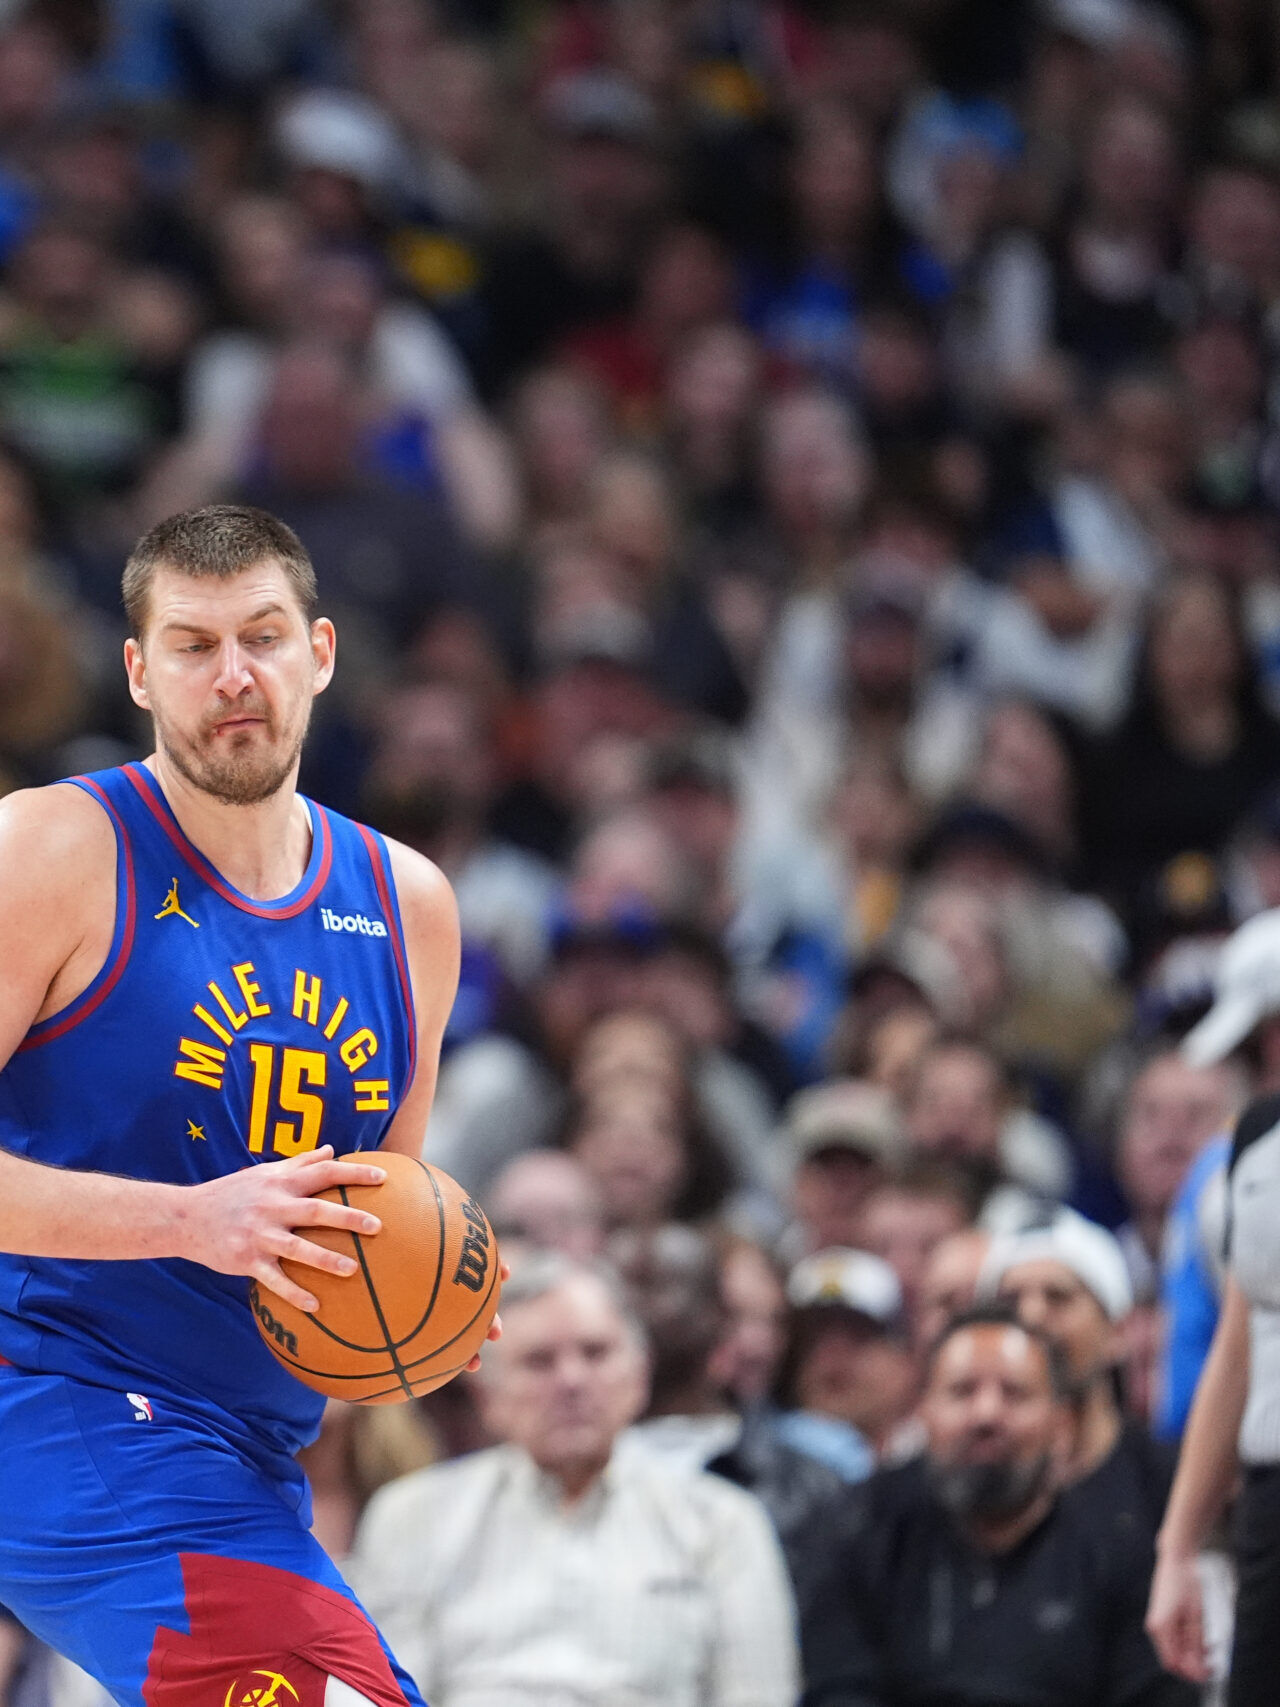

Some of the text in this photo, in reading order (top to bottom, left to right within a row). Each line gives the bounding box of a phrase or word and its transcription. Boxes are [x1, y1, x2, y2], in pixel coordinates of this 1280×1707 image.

[321, 908, 387, 937] ibotta
[174, 961, 390, 1112] MILE HIGH
[248, 1043, 327, 1158] 15
